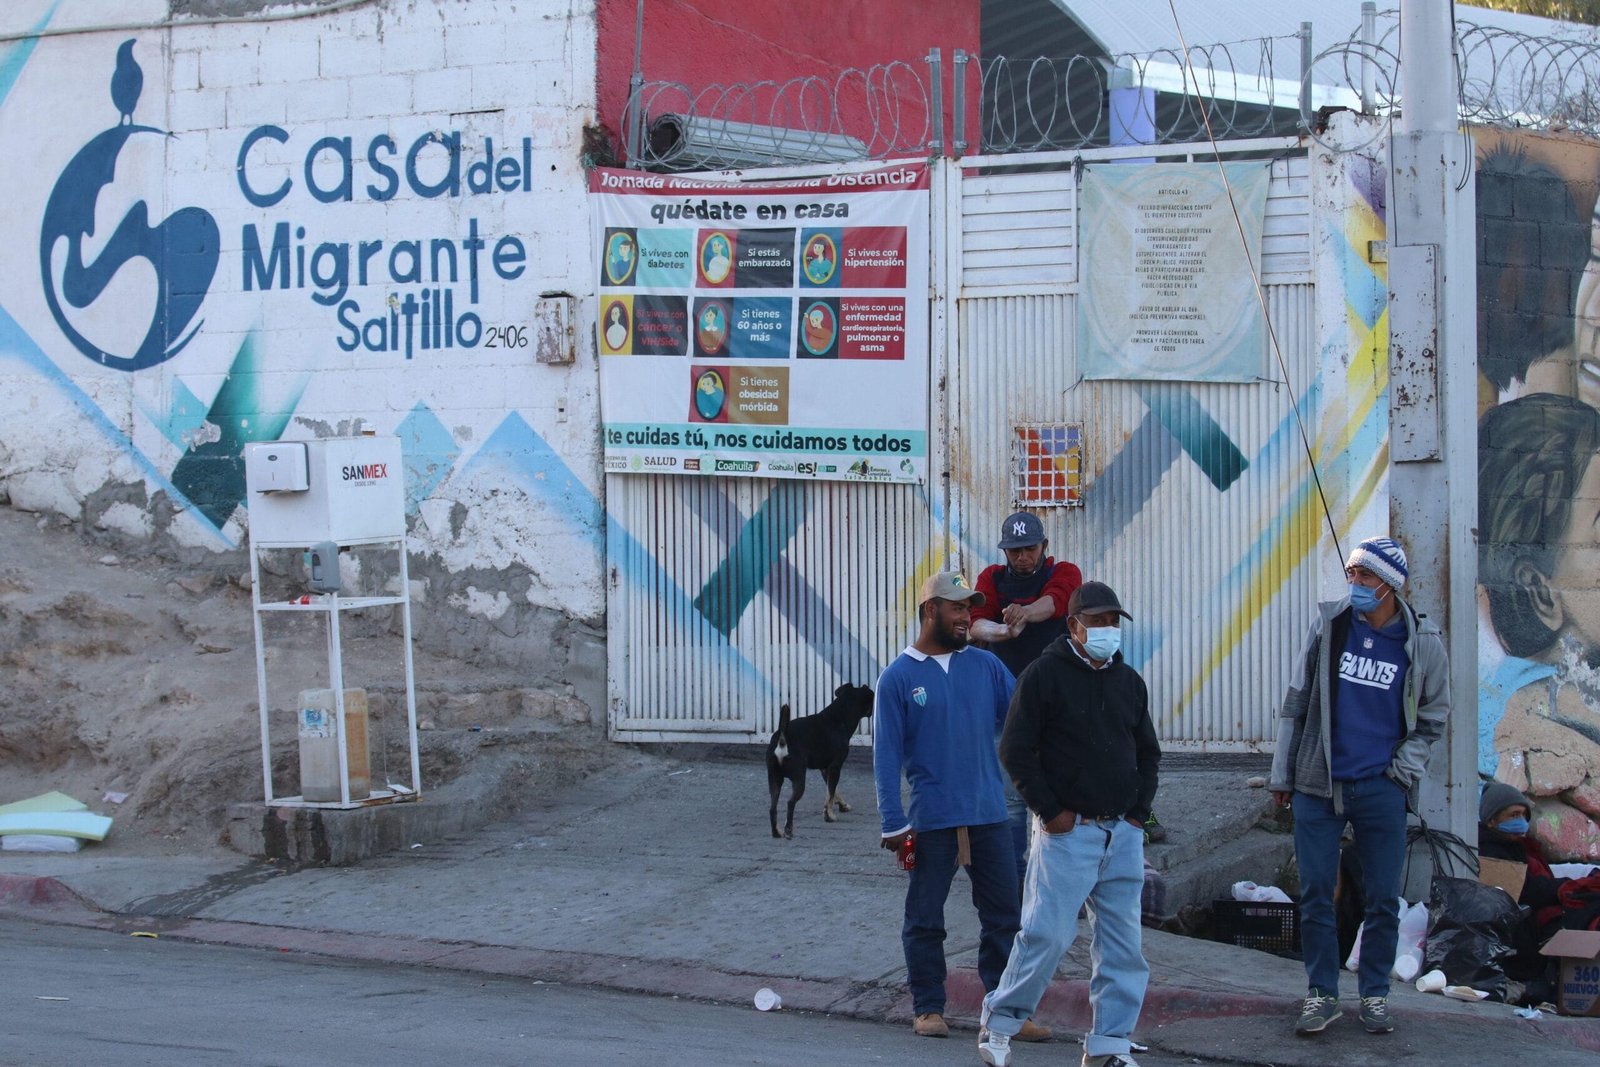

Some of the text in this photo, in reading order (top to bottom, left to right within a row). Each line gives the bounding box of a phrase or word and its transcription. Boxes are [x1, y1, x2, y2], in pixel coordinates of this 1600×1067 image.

[236, 124, 532, 208] Casa del
[601, 172, 664, 189] Jornada
[827, 168, 917, 186] Distancia
[650, 200, 849, 224] quédate en casa
[641, 248, 689, 258] Si vives con
[748, 248, 780, 256] Si estás
[848, 248, 856, 256] Si
[858, 248, 881, 256] vives
[241, 217, 527, 306] Migrante
[648, 259, 684, 269] diabetes
[738, 258, 791, 267] embarazada
[844, 258, 904, 268] hipertensión
[636, 310, 644, 318] Si
[646, 310, 670, 318] vives
[742, 310, 780, 318] Si tienes
[845, 313, 902, 321] enfermedad
[336, 287, 483, 360] Saltillo
[737, 322, 749, 330] 60
[752, 322, 774, 330] años
[842, 324, 904, 332] cardiorespiratoria,
[484, 325, 528, 348] 2406
[750, 332, 770, 342] más
[846, 334, 891, 342] pulmonar
[740, 377, 778, 386] Si tienes
[738, 389, 779, 399] obesidad
[739, 402, 778, 412] mórbida
[608, 426, 912, 452] te cuidas tú, nos cuidamos todos
[644, 456, 677, 466] SALUD
[716, 461, 754, 471] Coahuila
[342, 464, 388, 480] SANMEX
[1012, 521, 1027, 536] NY
[1339, 652, 1398, 684] GIANTS
[1574, 966, 1600, 983] 360
